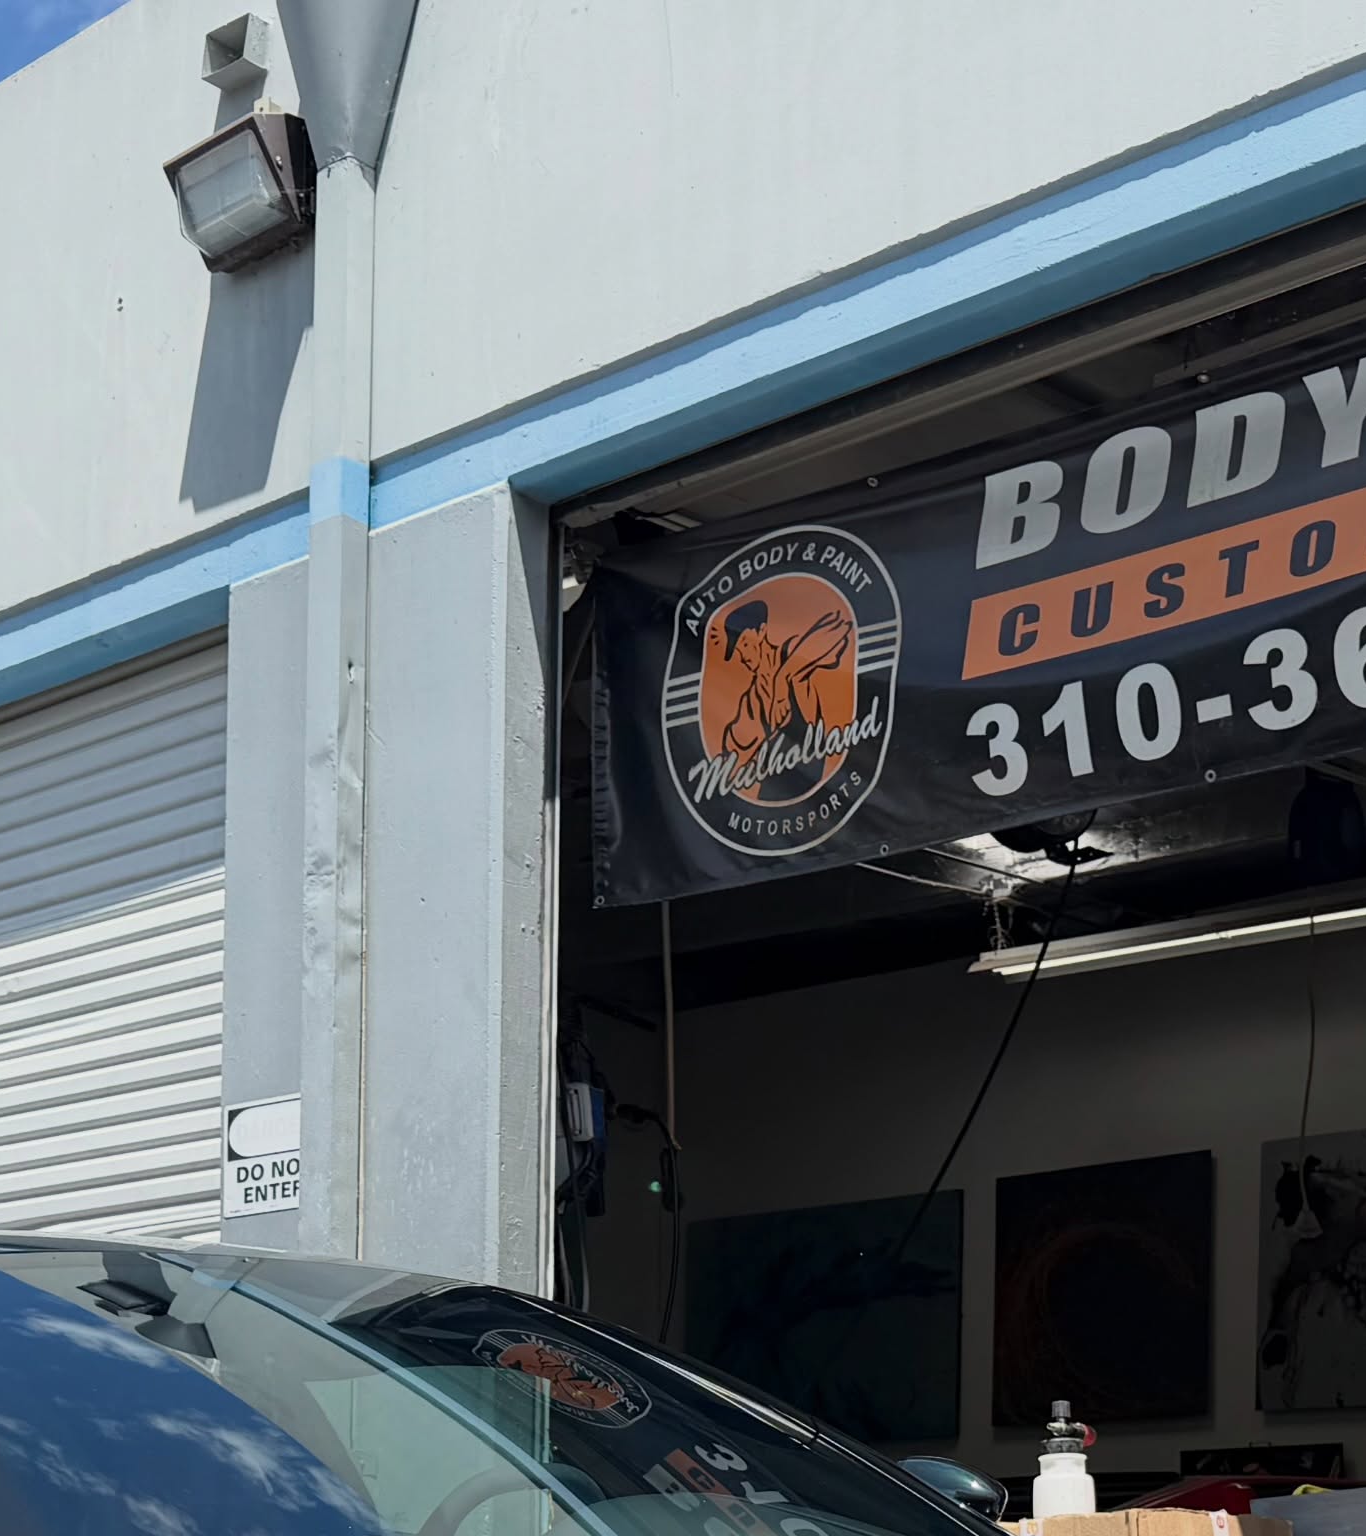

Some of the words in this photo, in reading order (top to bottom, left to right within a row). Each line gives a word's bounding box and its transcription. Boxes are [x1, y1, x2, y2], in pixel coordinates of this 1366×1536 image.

[685, 575, 733, 637] AUTO
[738, 543, 799, 578] BODY
[802, 542, 817, 561] &
[819, 545, 874, 594] PAINT
[688, 696, 882, 803] Mulholland
[728, 771, 863, 837] MOTORSPORTS
[237, 1163, 264, 1183] DO
[272, 1158, 299, 1178] NO
